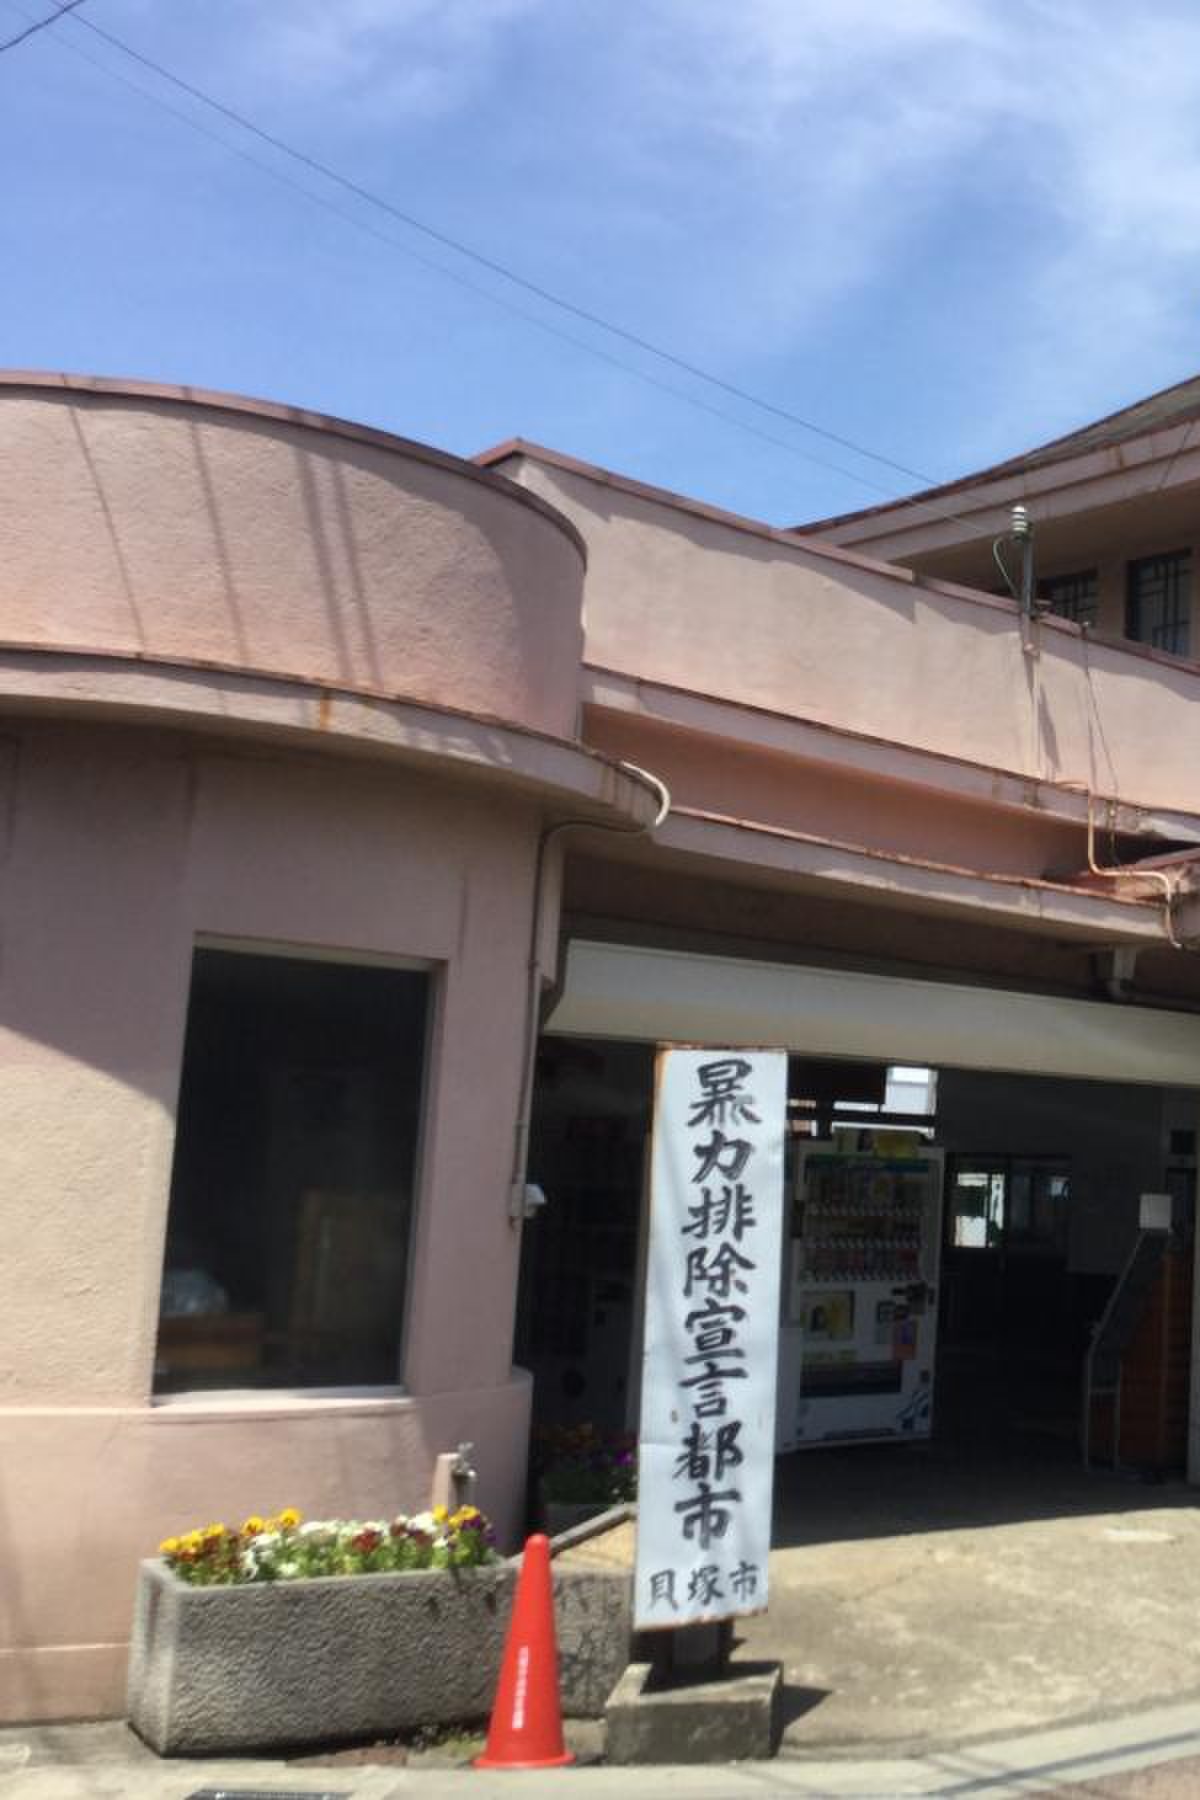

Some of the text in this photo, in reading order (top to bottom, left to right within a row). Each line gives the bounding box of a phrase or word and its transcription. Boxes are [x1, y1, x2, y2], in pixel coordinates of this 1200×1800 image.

[672, 1058, 762, 1551] 暴力排除宣言都市
[648, 1560, 760, 1611] 貝塚市
